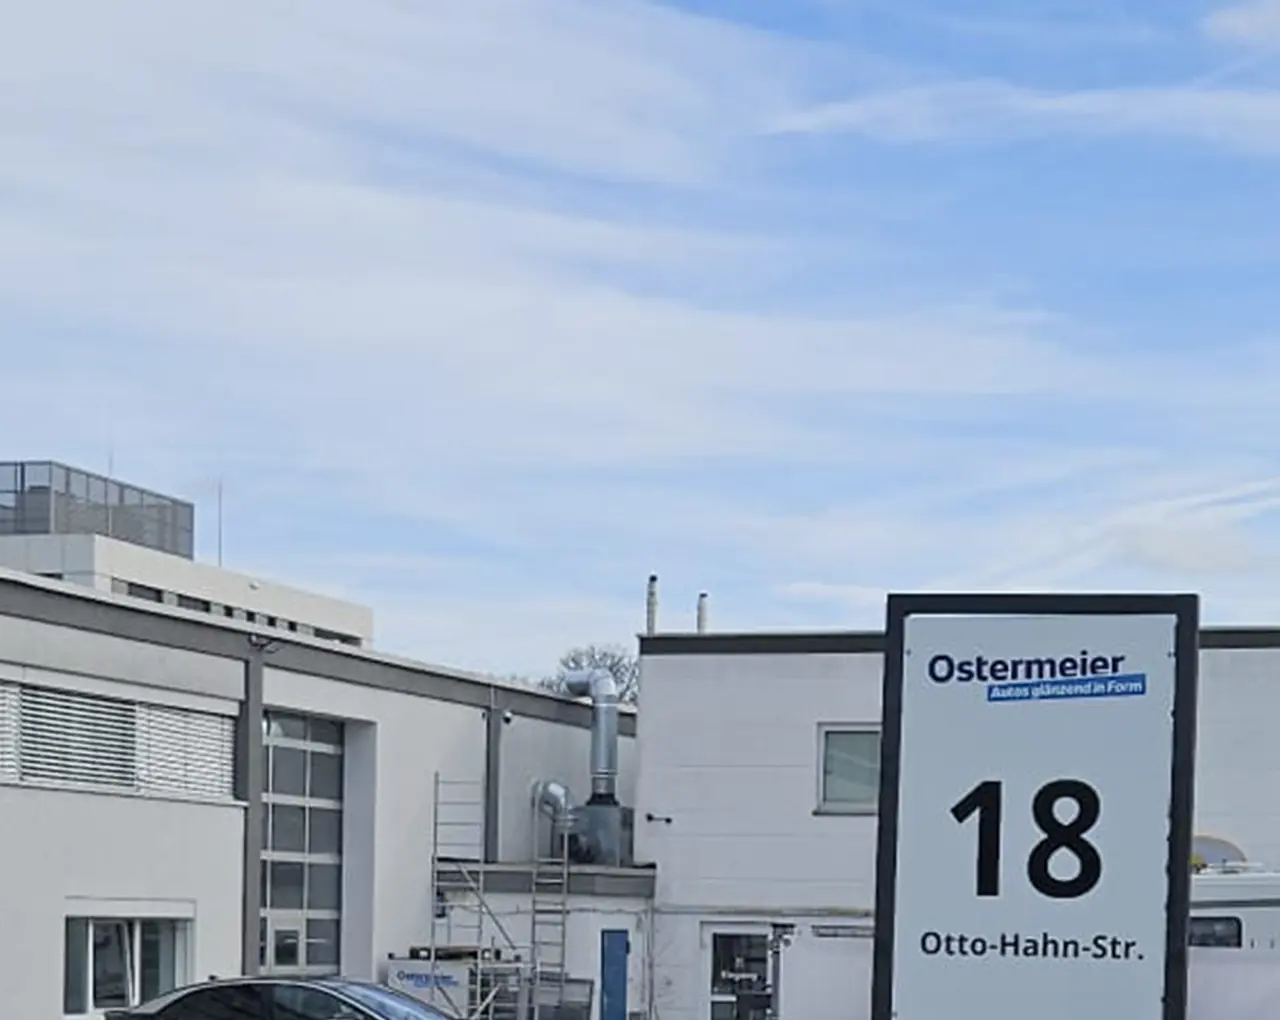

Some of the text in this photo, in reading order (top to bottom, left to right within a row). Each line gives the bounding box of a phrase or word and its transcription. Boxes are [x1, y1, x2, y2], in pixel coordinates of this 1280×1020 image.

[928, 650, 1126, 683] Ostermeier
[990, 679, 1143, 699] Autos glänzend in Form
[950, 779, 1102, 899] 18
[919, 931, 1145, 960] Otto-Hahn-Str.
